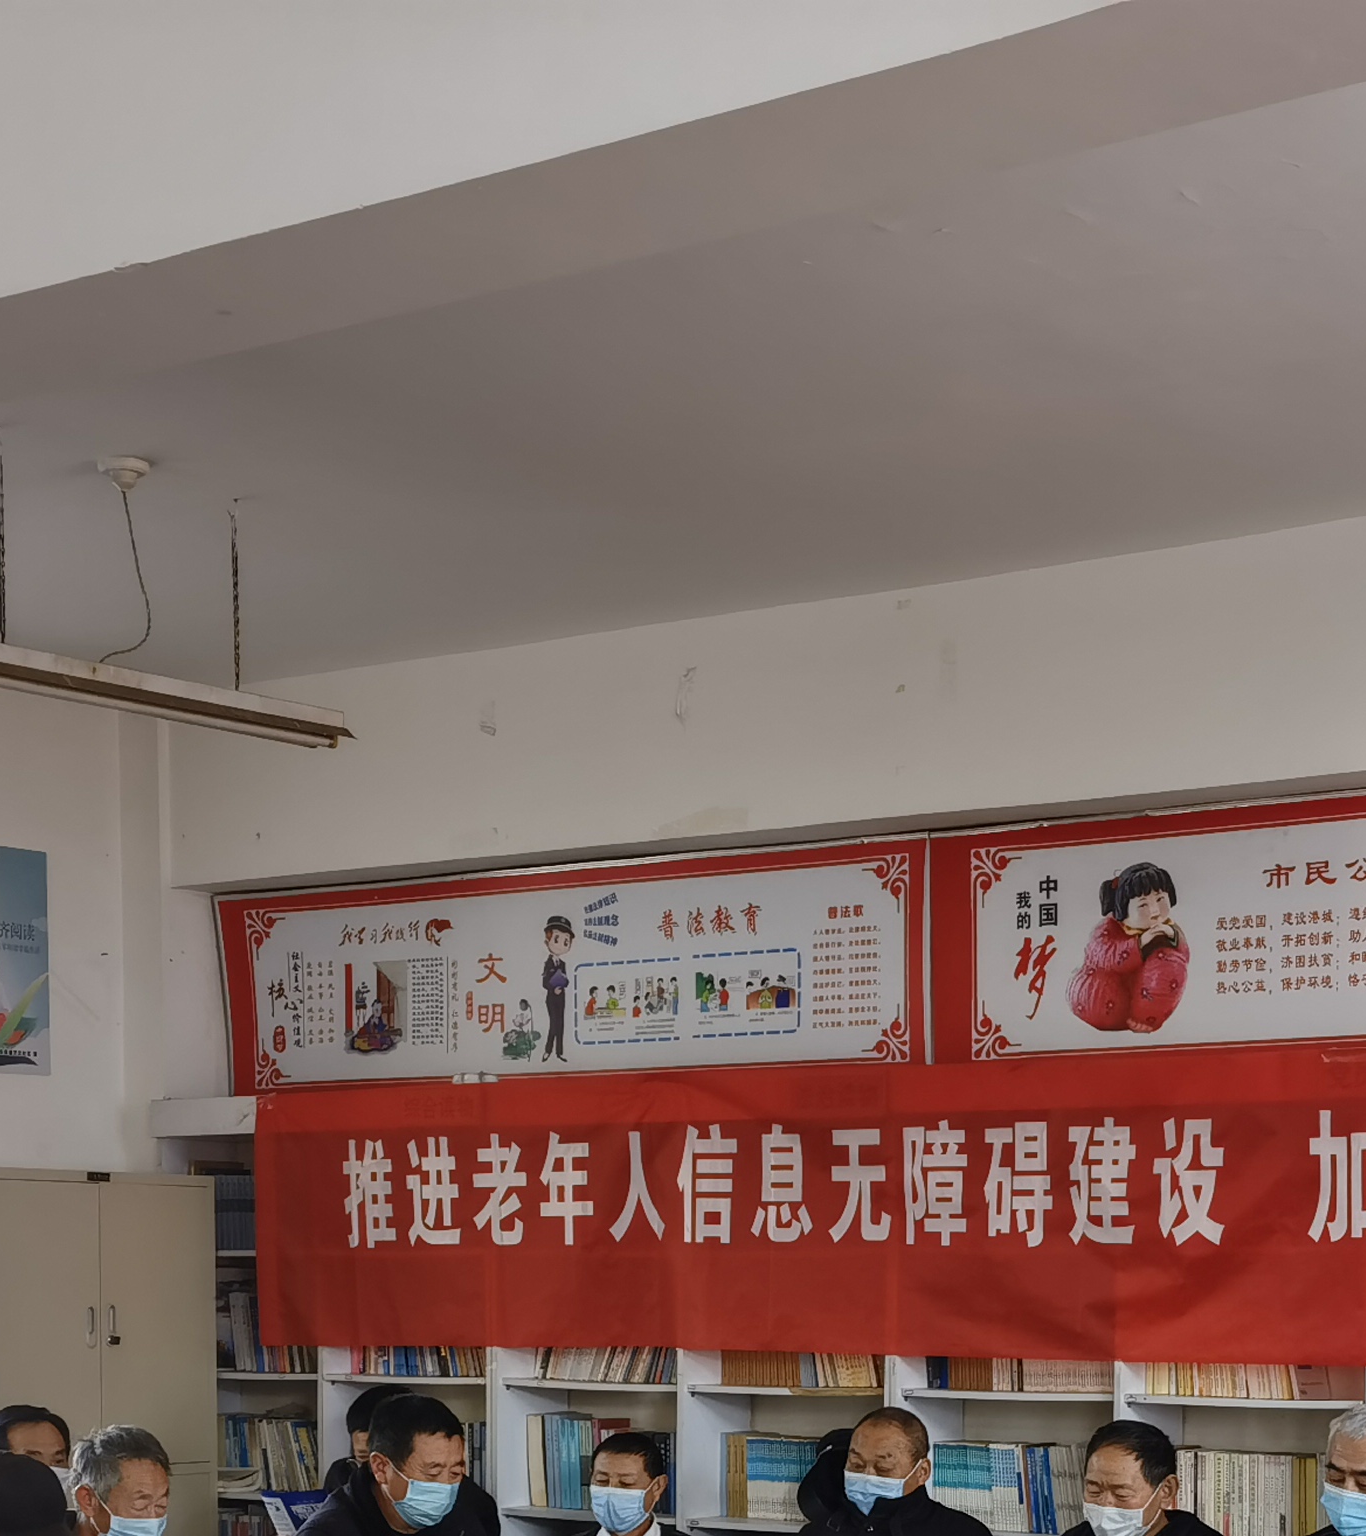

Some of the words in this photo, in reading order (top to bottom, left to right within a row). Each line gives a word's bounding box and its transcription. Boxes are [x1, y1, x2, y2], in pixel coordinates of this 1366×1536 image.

[656, 901, 763, 942] 普法教育
[1015, 890, 1032, 930] 我的
[1039, 875, 1059, 928] 中国
[475, 952, 508, 1034] 文明
[1013, 934, 1058, 1021] 梦
[341, 1117, 1227, 1251] 推进老年人信息无障碍建设
